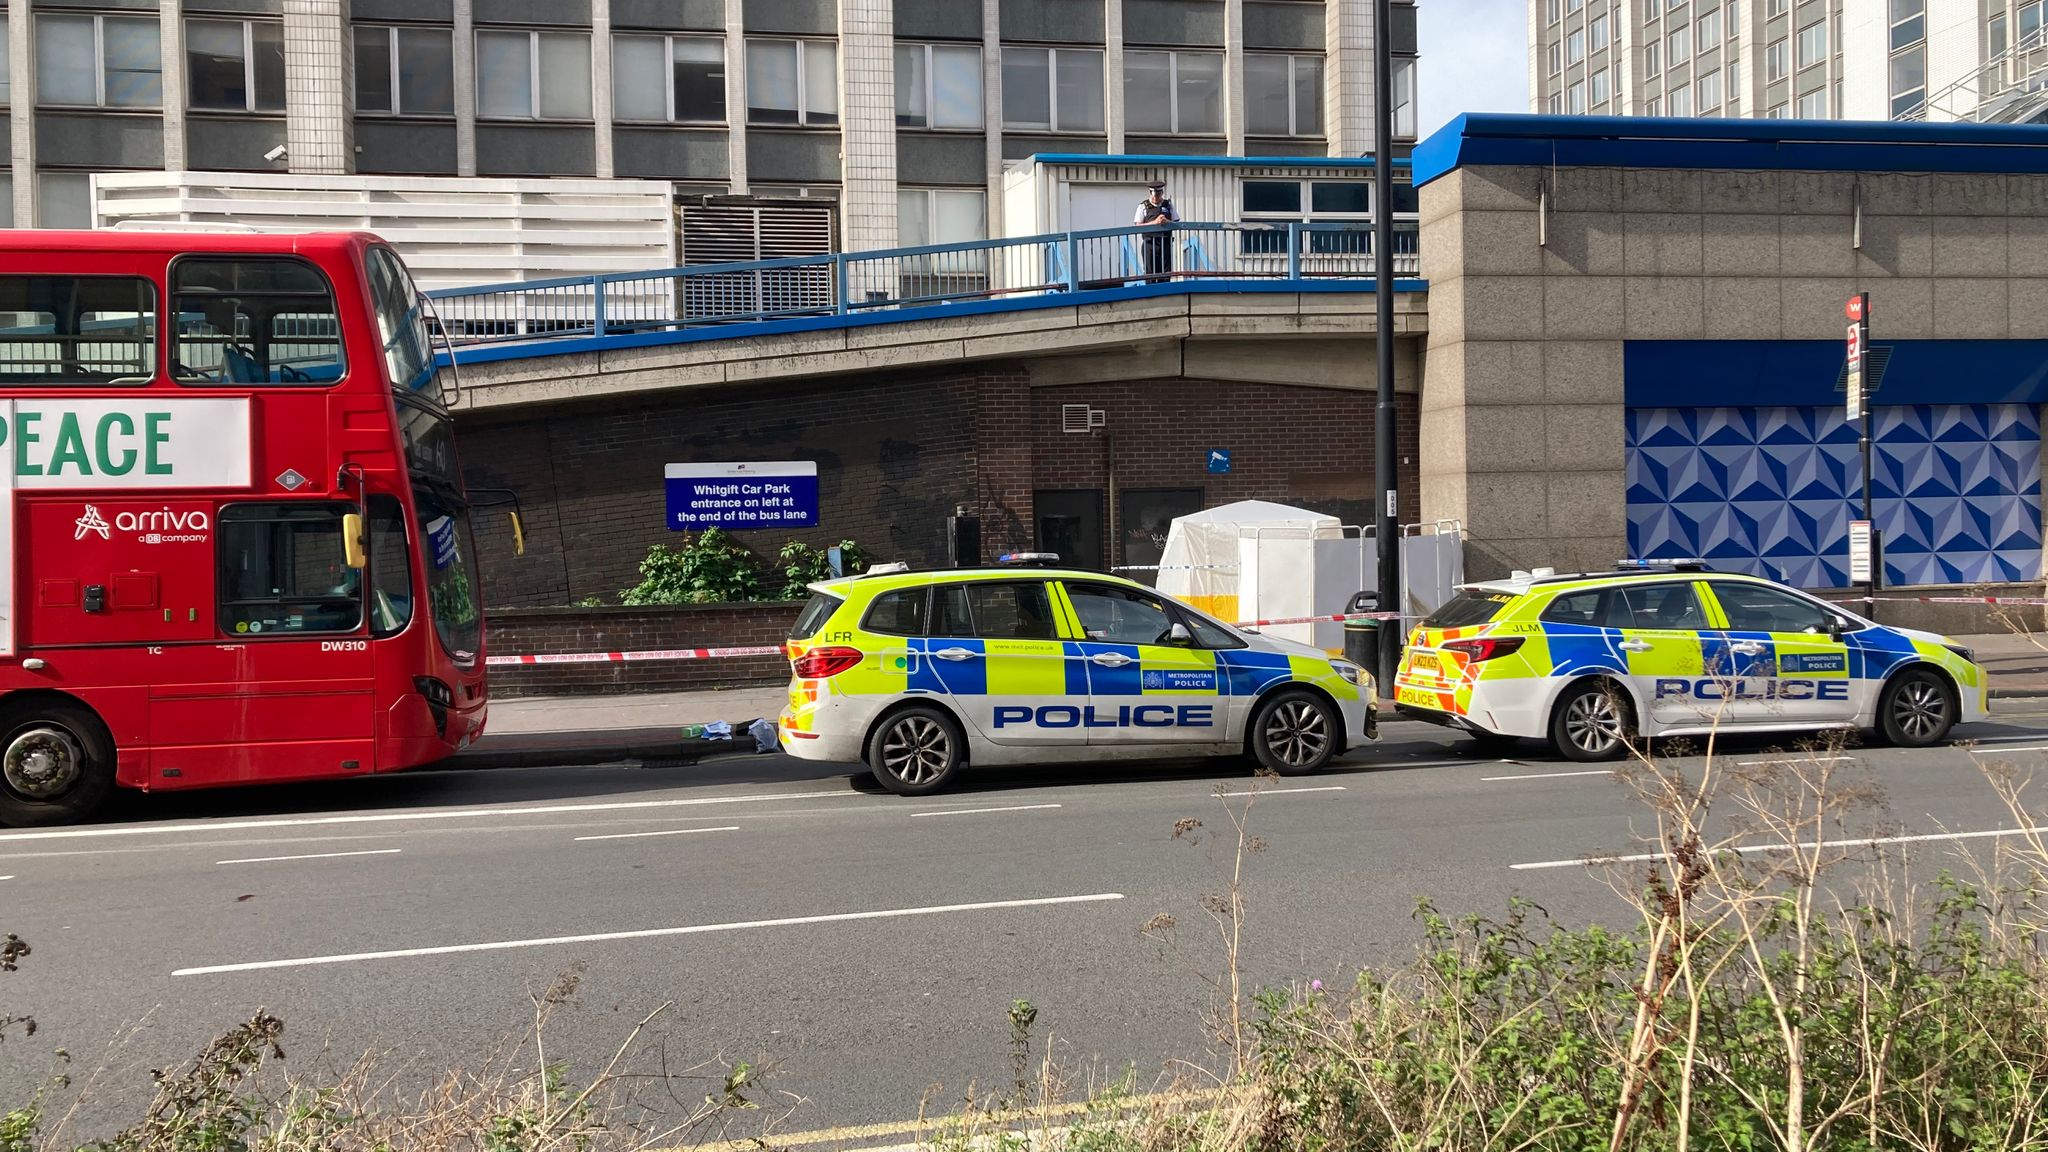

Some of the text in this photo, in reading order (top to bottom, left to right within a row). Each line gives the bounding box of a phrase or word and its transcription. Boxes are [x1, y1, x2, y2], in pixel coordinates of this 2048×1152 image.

[0, 411, 173, 476] EACE
[694, 484, 791, 497] Whitgift Car Park
[691, 497, 794, 508] entrance on left at
[115, 506, 208, 531] arriva
[678, 509, 808, 522] the end of the bus lane
[138, 534, 208, 544] a DB company
[1487, 594, 1512, 604] JLM
[1512, 624, 1541, 633] JLM
[825, 631, 852, 643] LFR
[147, 646, 163, 655] TC
[321, 640, 367, 652] DW310
[1655, 678, 1849, 700] POLICE
[1401, 690, 1435, 706] POLICE
[993, 705, 1214, 729] POLICE
